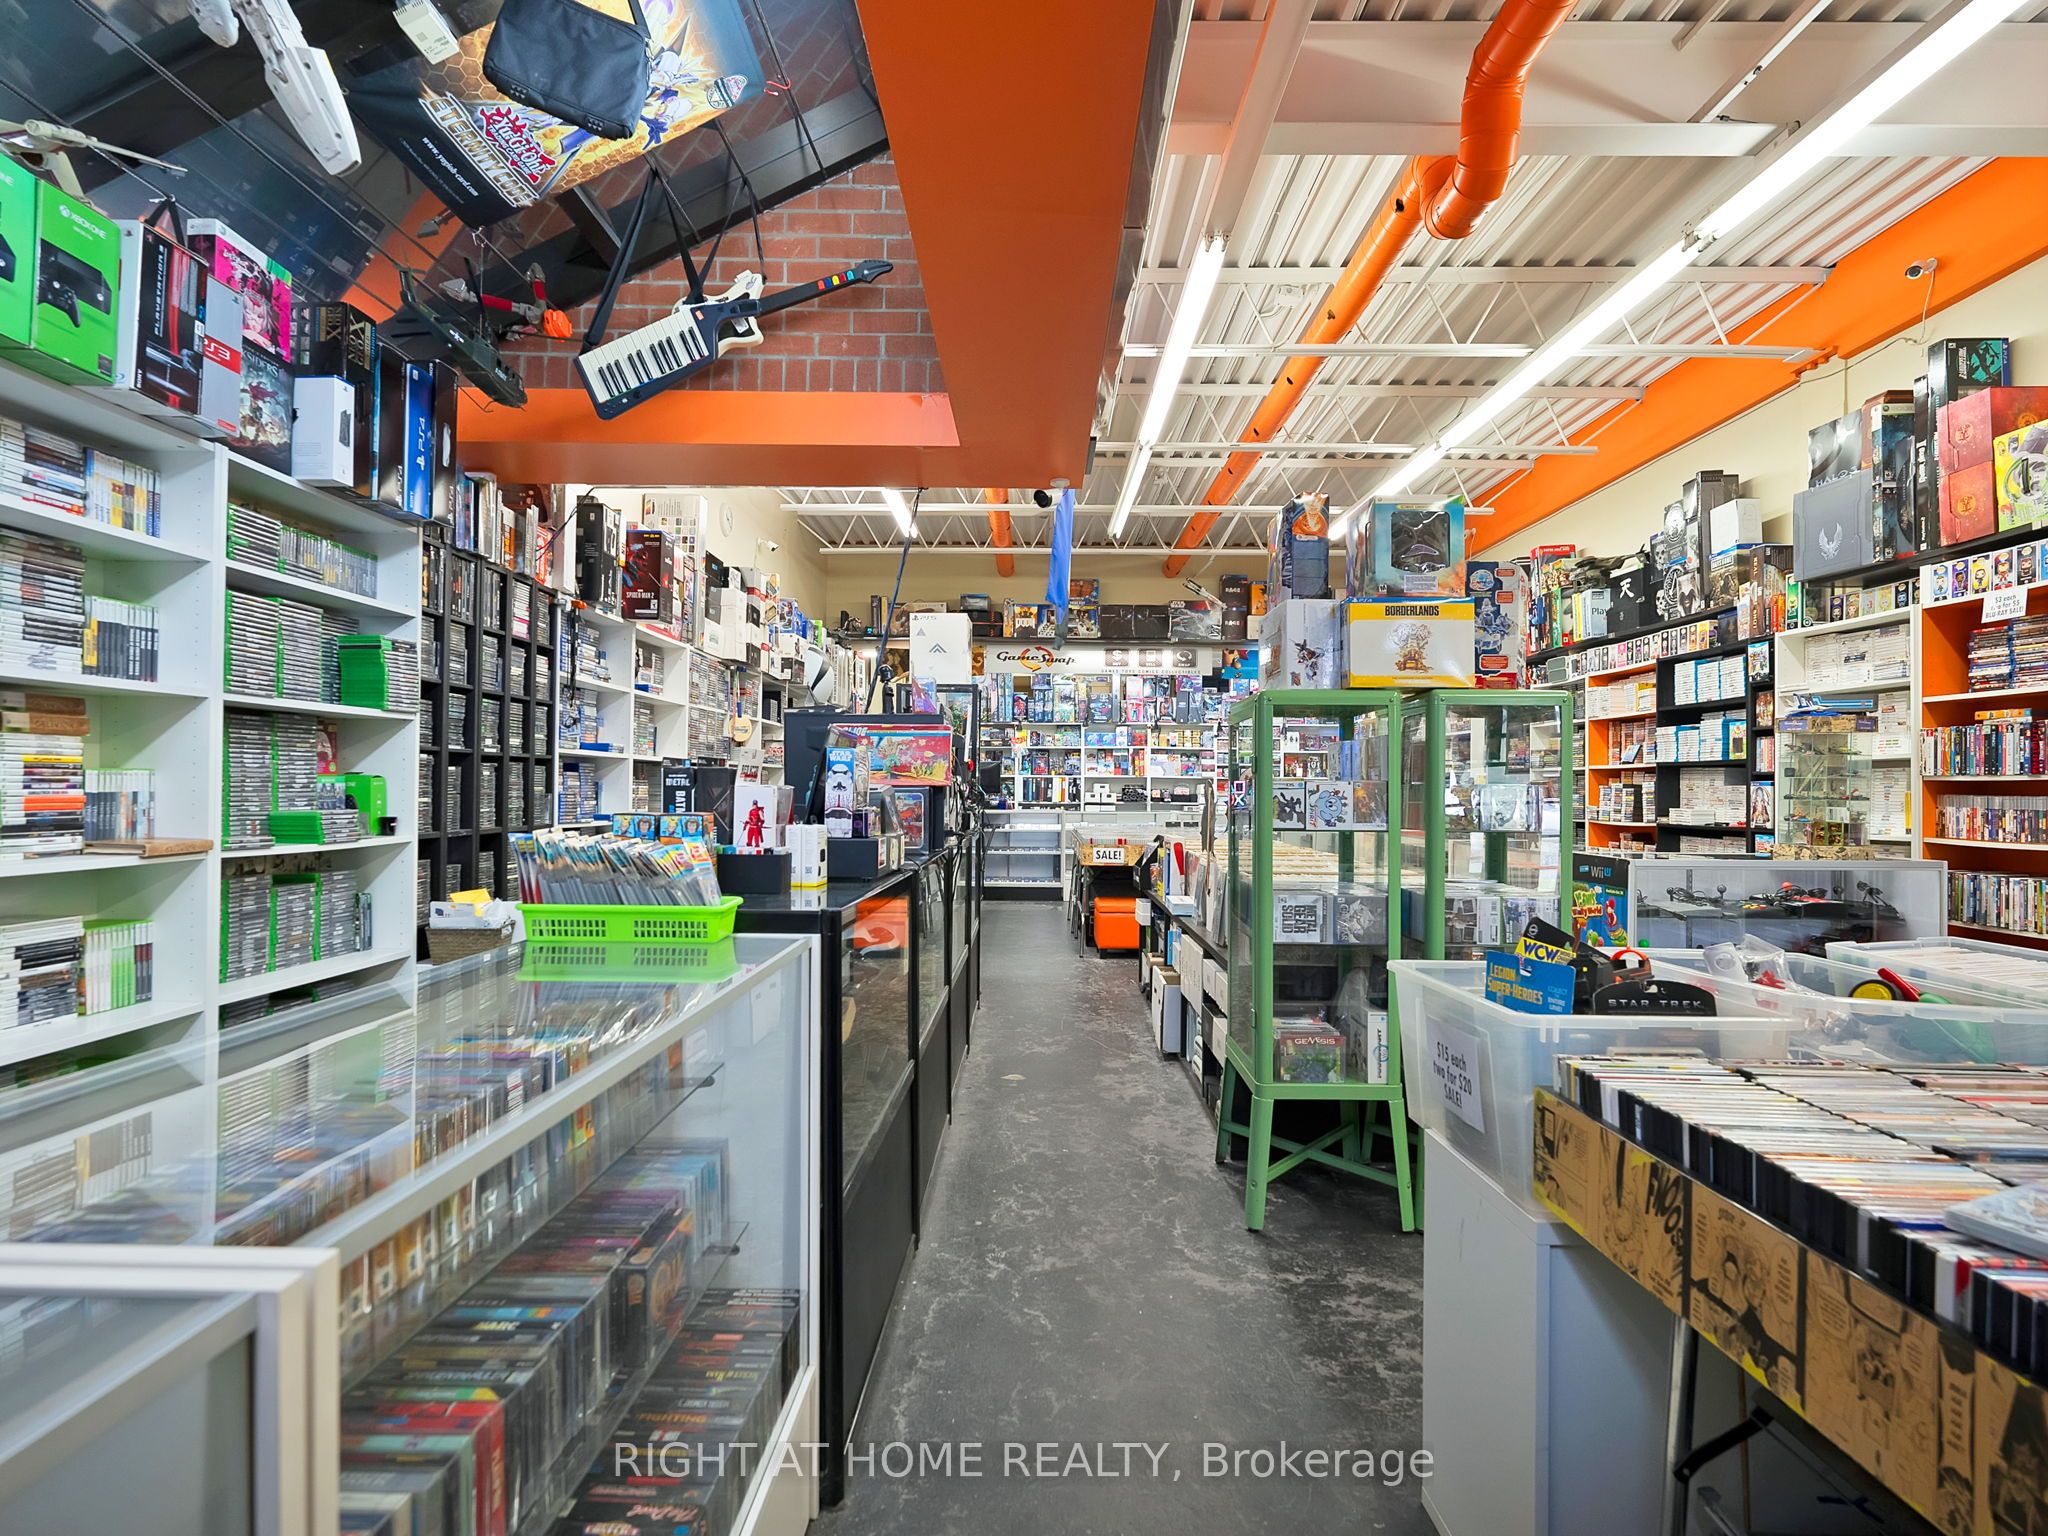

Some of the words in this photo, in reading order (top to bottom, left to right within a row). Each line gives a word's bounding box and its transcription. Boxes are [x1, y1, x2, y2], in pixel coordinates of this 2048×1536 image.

[429, 97, 505, 174] ETERNITY
[492, 170, 535, 205] CODE
[1384, 605, 1440, 617] BORDERLANDS
[1095, 850, 1122, 860] SALE!
[1590, 865, 1604, 879] Wii
[1281, 904, 1294, 934] SOLID
[1294, 904, 1307, 934] GEAR
[1306, 904, 1317, 934] METAL
[1523, 939, 1560, 963] WCW
[1489, 962, 1517, 982] LEGION
[1608, 998, 1650, 1009] STAR
[1659, 999, 1703, 1009] TREK
[1294, 1036, 1336, 1046] GENESIS
[1437, 1041, 1449, 1062] $15
[1450, 1053, 1467, 1073] each
[1433, 1060, 1446, 1079] two
[1446, 1066, 1457, 1086] for
[1458, 1073, 1472, 1096] $20
[1443, 1083, 1463, 1109] SALE!
